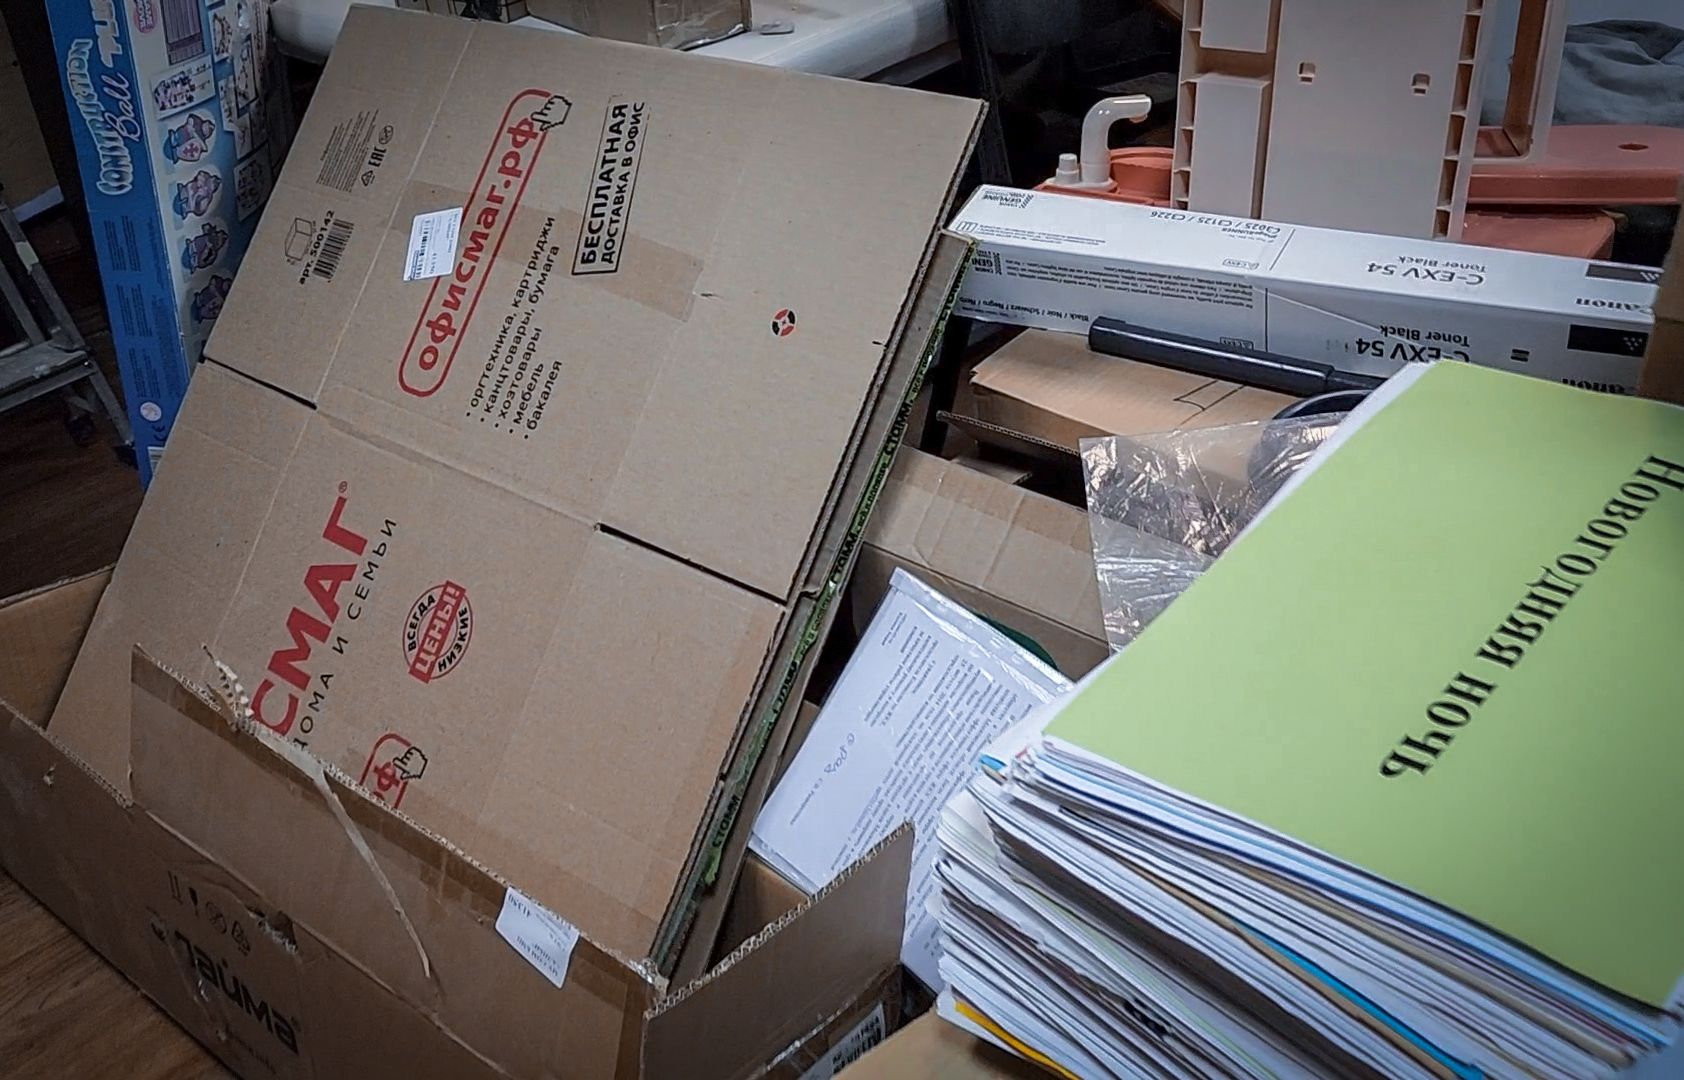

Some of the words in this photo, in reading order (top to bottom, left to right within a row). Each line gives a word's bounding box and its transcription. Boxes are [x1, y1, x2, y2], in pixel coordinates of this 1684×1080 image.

[101, 72, 141, 142] Ball
[624, 102, 646, 153] ОФИС
[580, 104, 628, 265] БЕСПЛАТНАЯ
[621, 156, 633, 168] В
[417, 117, 539, 371] офисмаг.рф
[601, 171, 630, 264] ДОСТАВКА
[1151, 211, 1185, 221] C3226
[1198, 217, 1232, 227] C3125
[1245, 223, 1281, 234] C3025
[299, 260, 314, 285] арт.
[310, 210, 335, 258] 500142
[1367, 262, 1397, 276] 54
[1399, 256, 1438, 267] Black
[1402, 267, 1484, 285] C-EXV
[1442, 261, 1486, 273] Toner
[469, 312, 518, 408] оргтехника,
[511, 216, 556, 309] картриджи
[483, 308, 536, 415] канцтовары,
[527, 245, 560, 304] бумага
[1380, 325, 1420, 341] Black
[1425, 331, 1470, 347] Toner
[497, 327, 542, 420] хозтовары
[1355, 338, 1385, 357] 54
[512, 363, 544, 425] мебель
[526, 360, 563, 432] бакалея
[332, 636, 349, 655] И
[346, 517, 397, 621] СЕМЬИ
[1474, 453, 1684, 670] Новогодняя
[407, 594, 436, 652] ВСЕГДА
[438, 607, 469, 673] НИЗКИЕ
[1378, 671, 1499, 779] ночь
